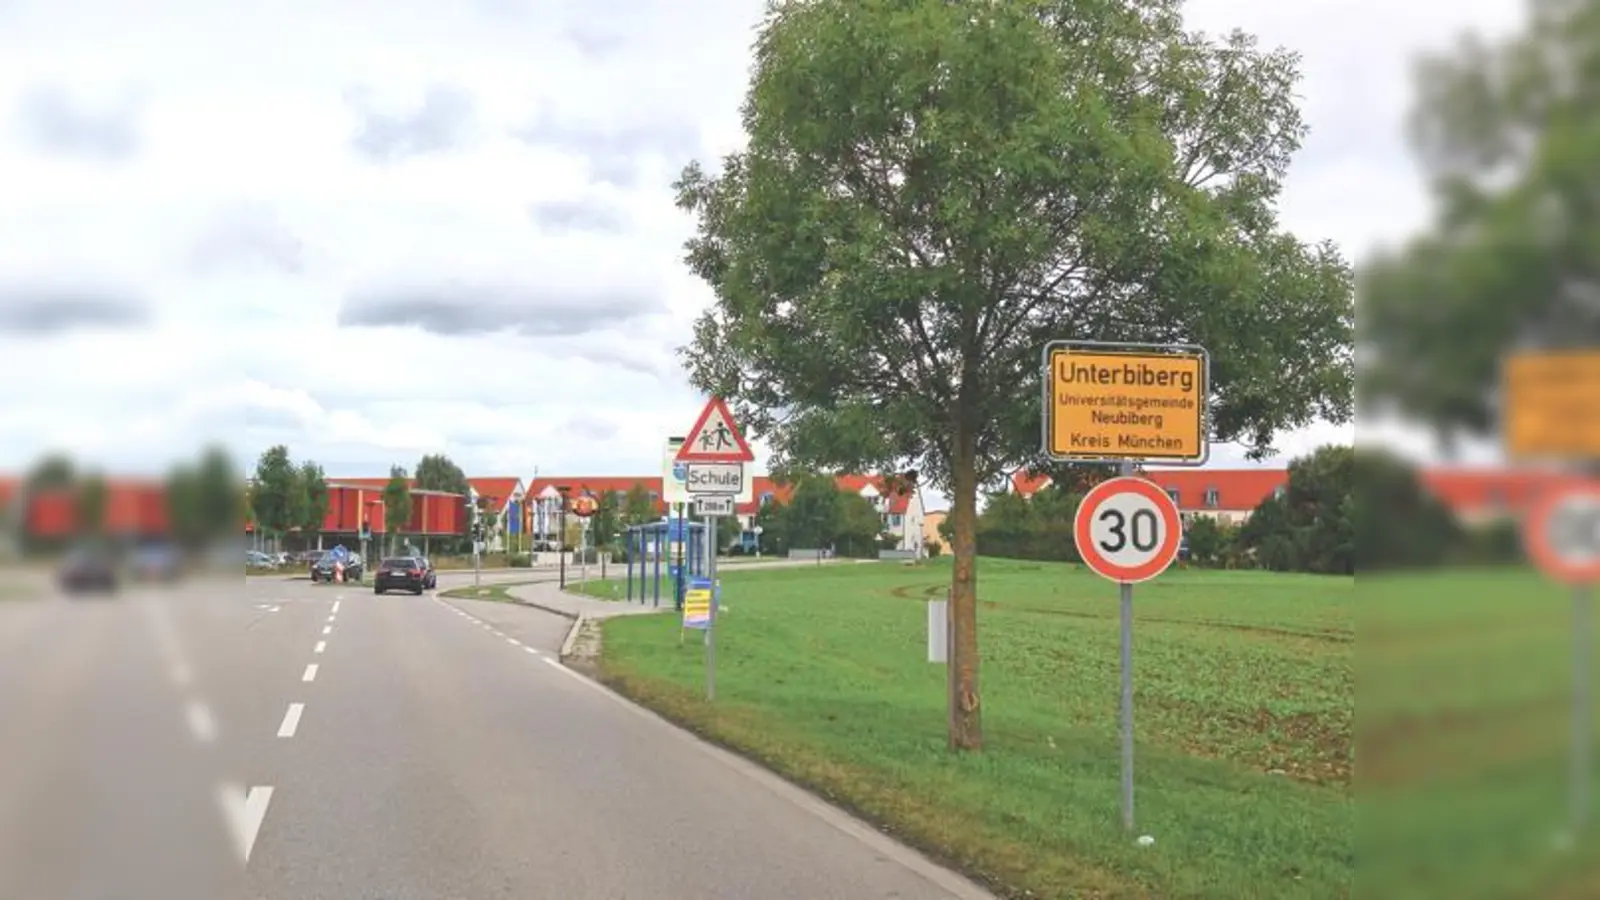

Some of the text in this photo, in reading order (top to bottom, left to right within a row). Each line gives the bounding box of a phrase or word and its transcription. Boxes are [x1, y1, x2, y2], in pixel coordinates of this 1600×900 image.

[1059, 361, 1193, 392] Unterbiberg
[1059, 393, 1194, 409] Universitätsgemeinde
[1091, 410, 1163, 429] Neubiberg
[1070, 432, 1183, 449] Kreis München
[689, 470, 739, 486] Schule
[1098, 507, 1159, 553] 30
